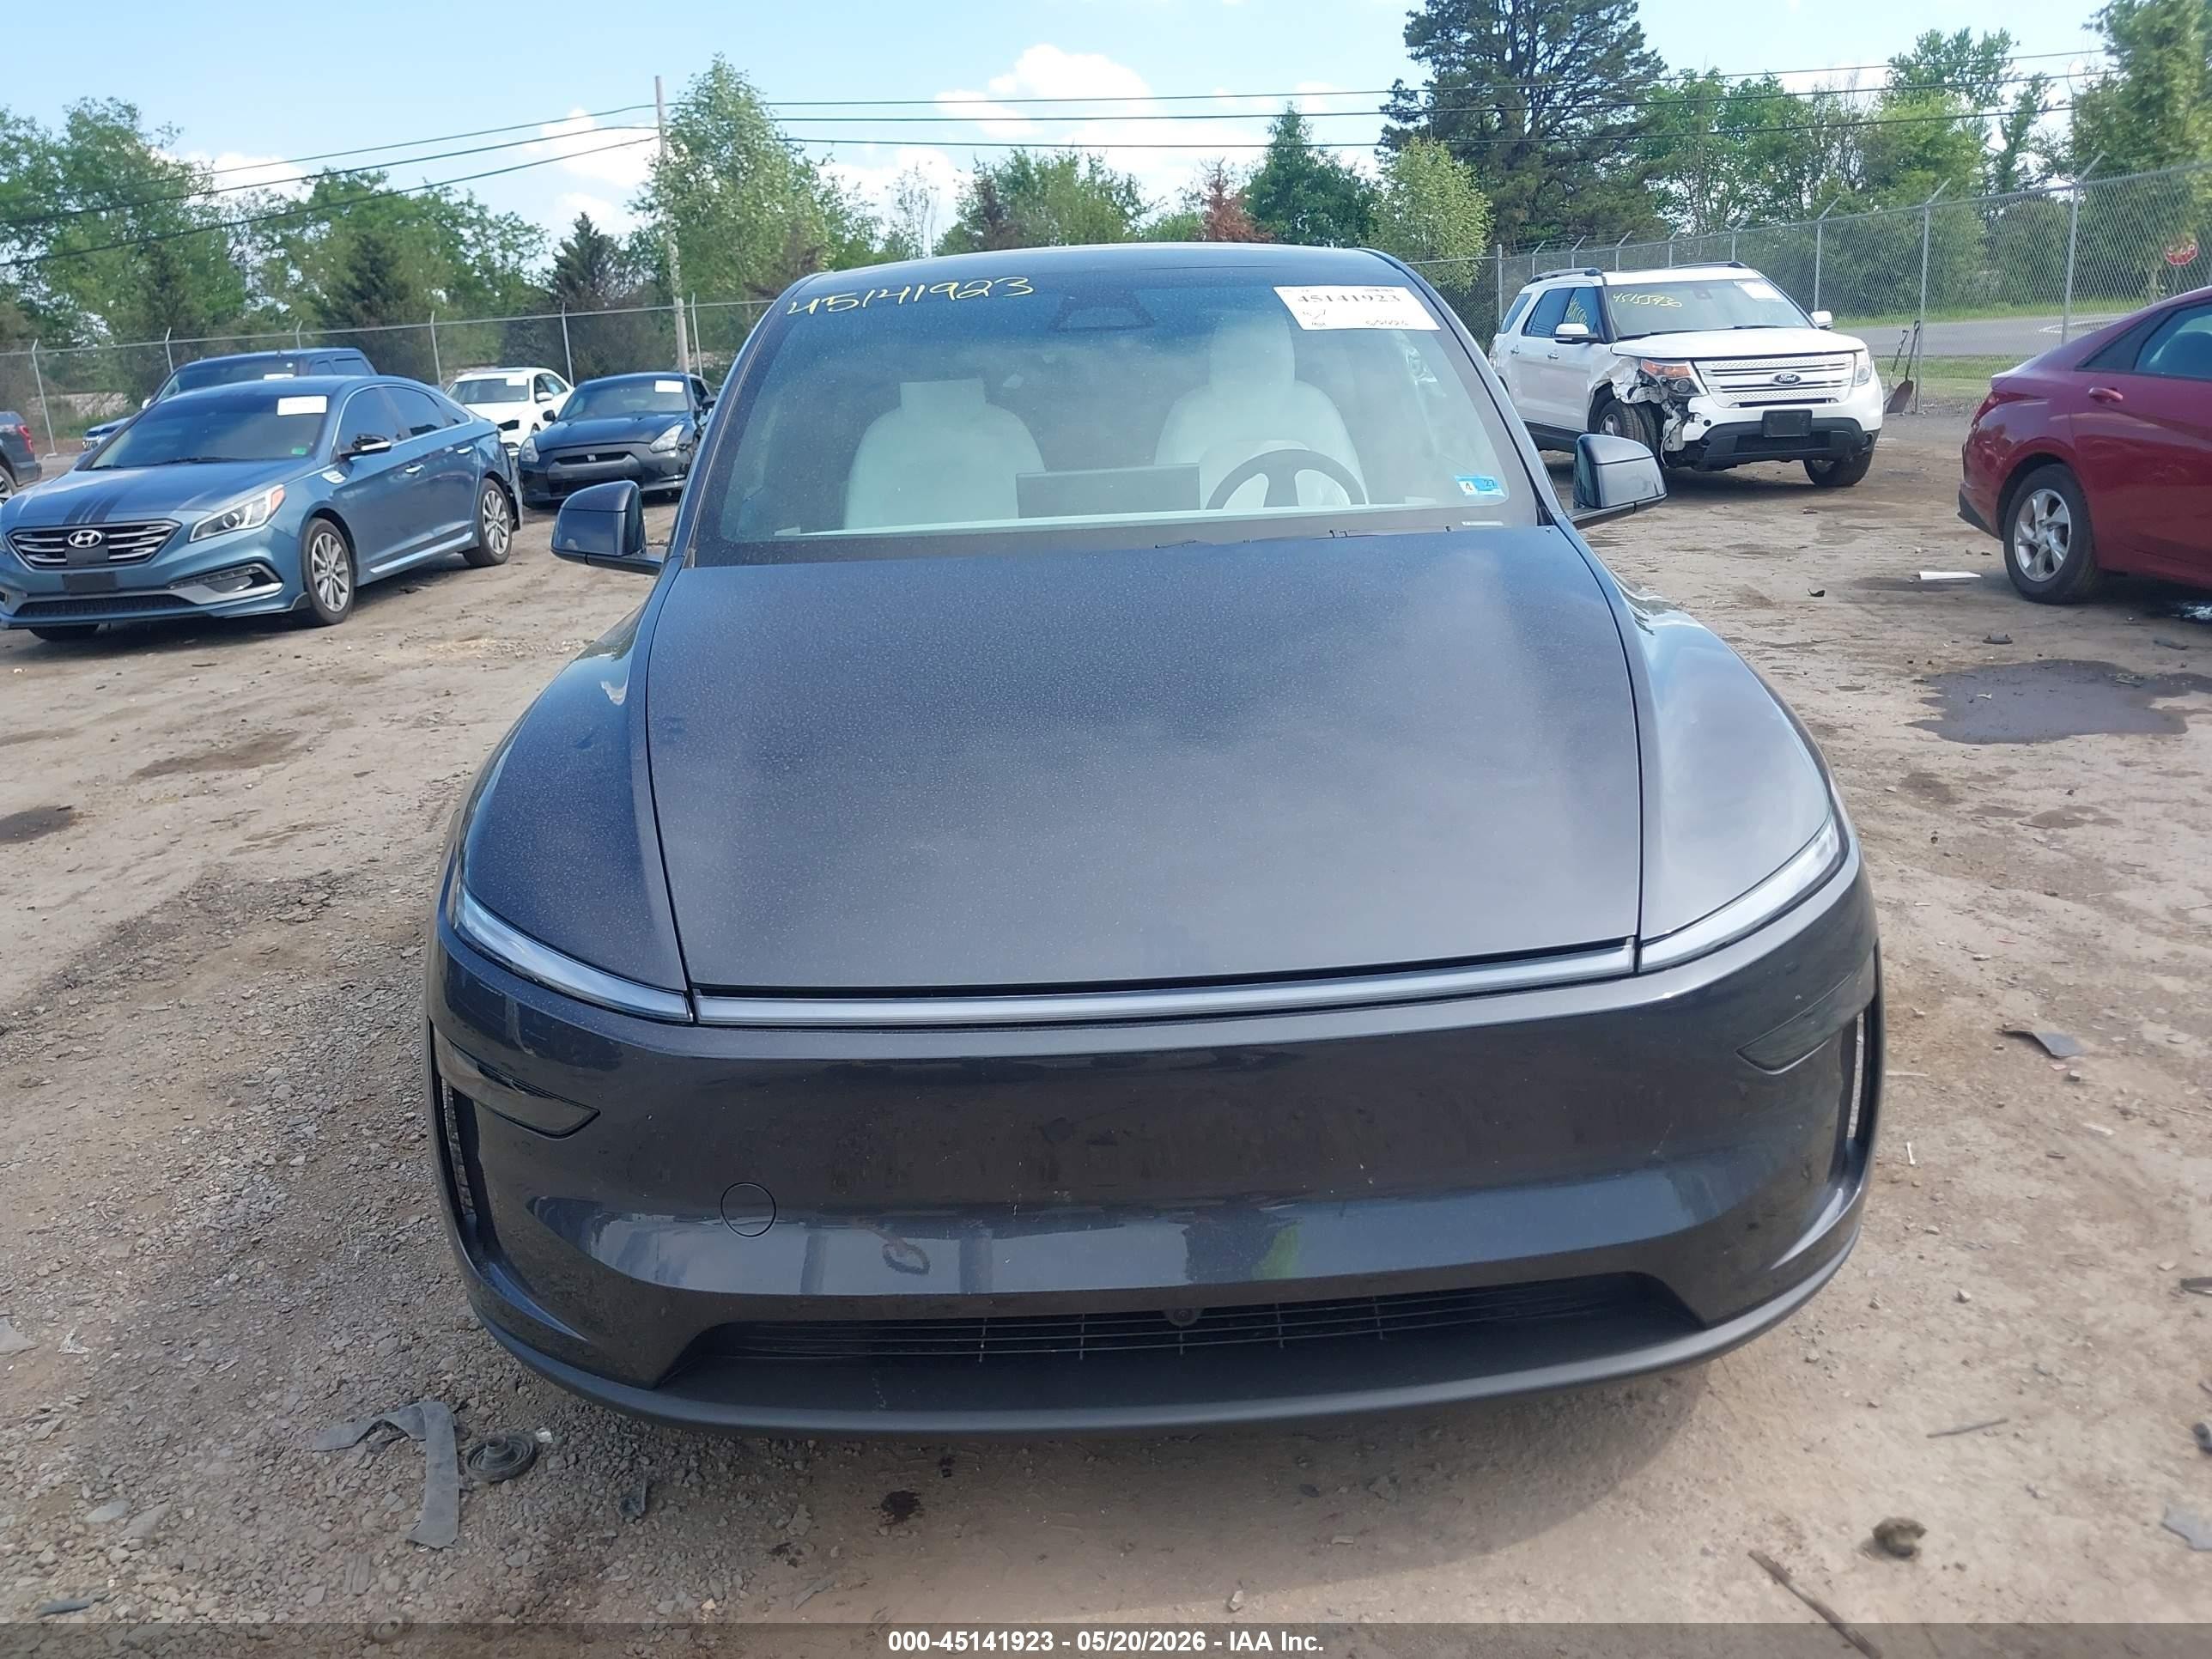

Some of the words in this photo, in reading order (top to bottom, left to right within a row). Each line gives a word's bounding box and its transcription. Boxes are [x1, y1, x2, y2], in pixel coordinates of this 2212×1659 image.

[786, 276, 1035, 316] 45141923
[1297, 295, 1401, 303] 45141923
[1778, 373, 1796, 382] Ford
